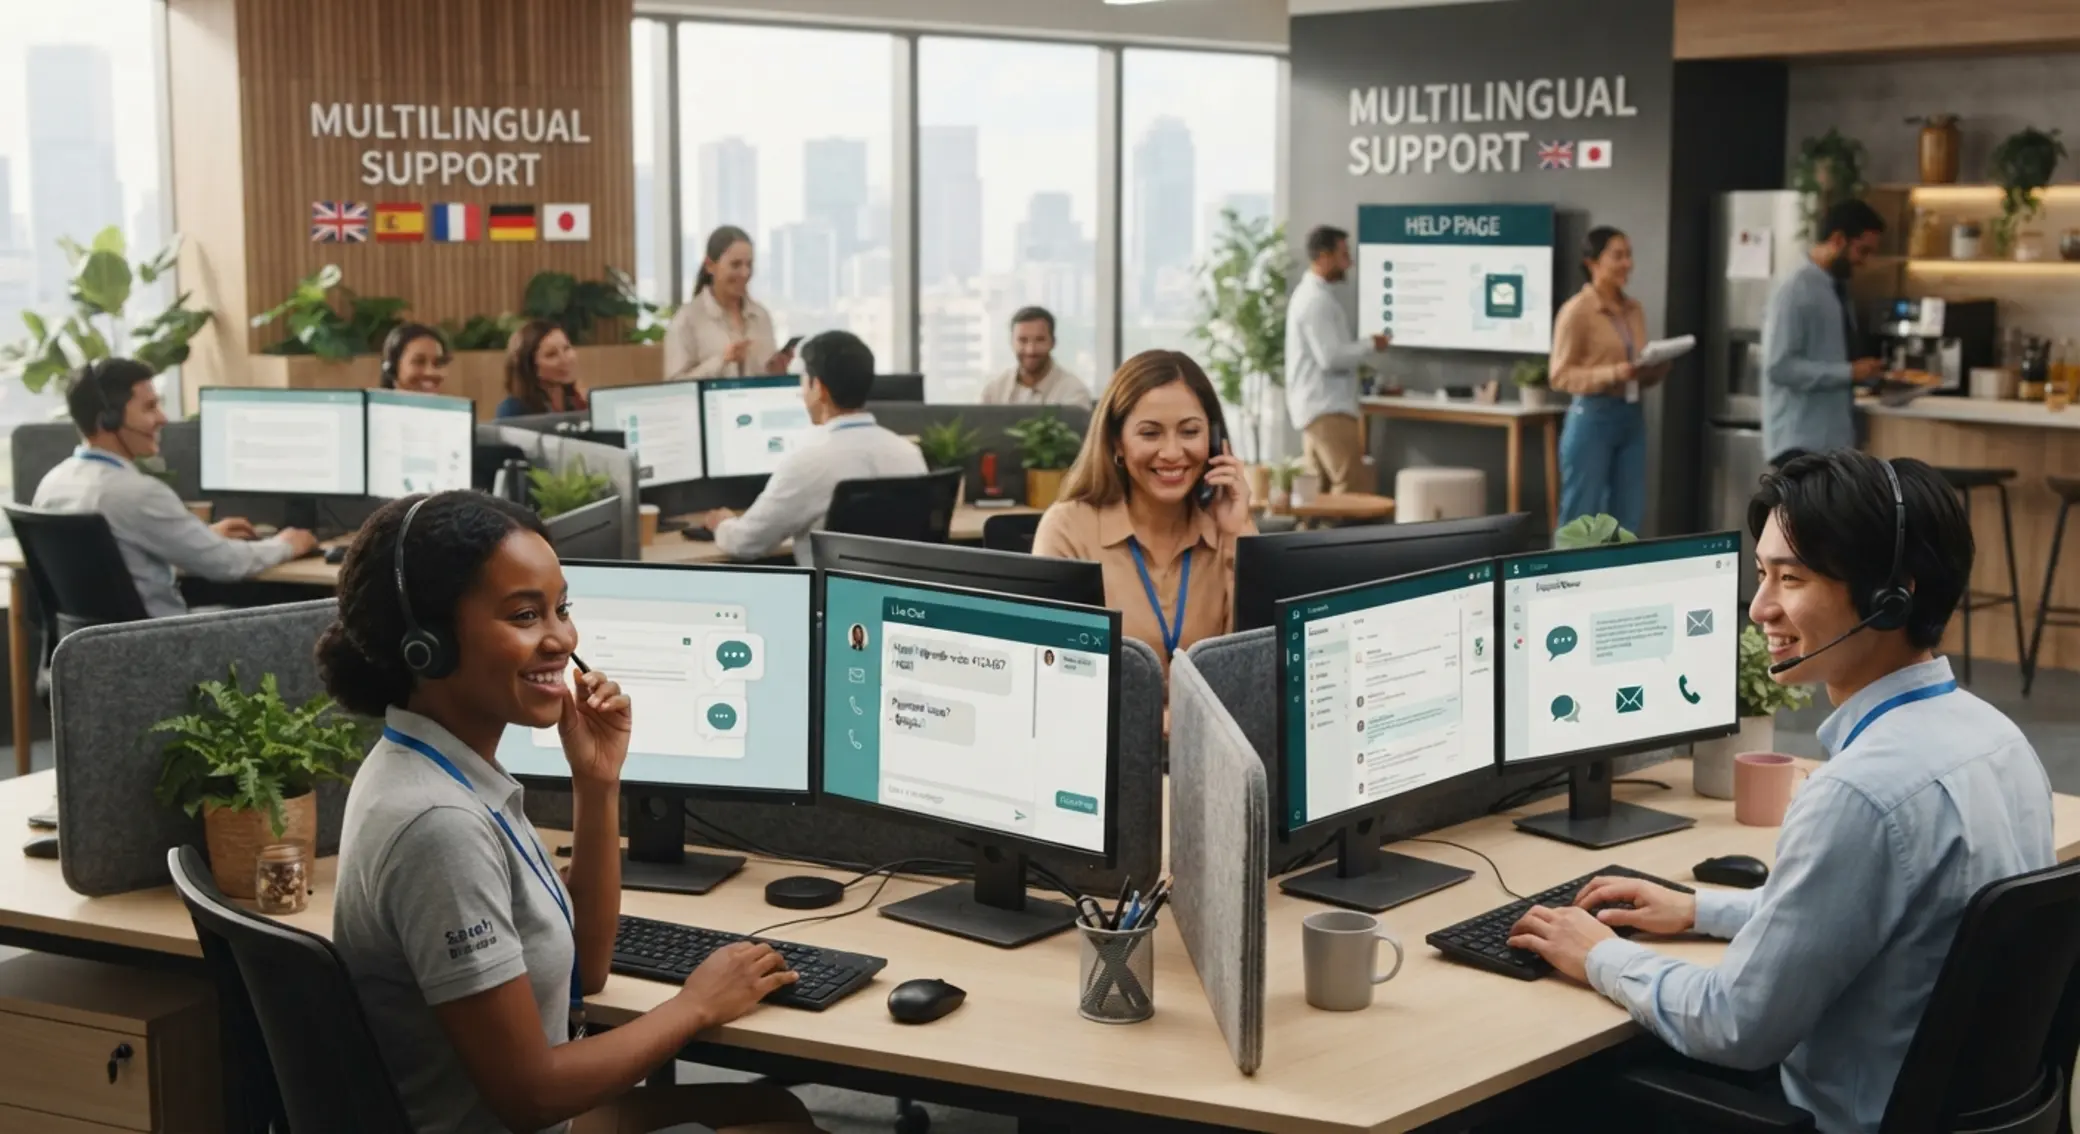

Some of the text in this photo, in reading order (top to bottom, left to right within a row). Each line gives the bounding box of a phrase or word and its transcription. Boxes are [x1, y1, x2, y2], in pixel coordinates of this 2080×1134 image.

[1349, 75, 1638, 127] MULTILINGUAL
[310, 102, 592, 143] MULTILINGUAL
[361, 150, 542, 187] SUPPORT
[1348, 132, 1530, 176] SUPPORT
[1404, 213, 1502, 237] HELP PAGE
